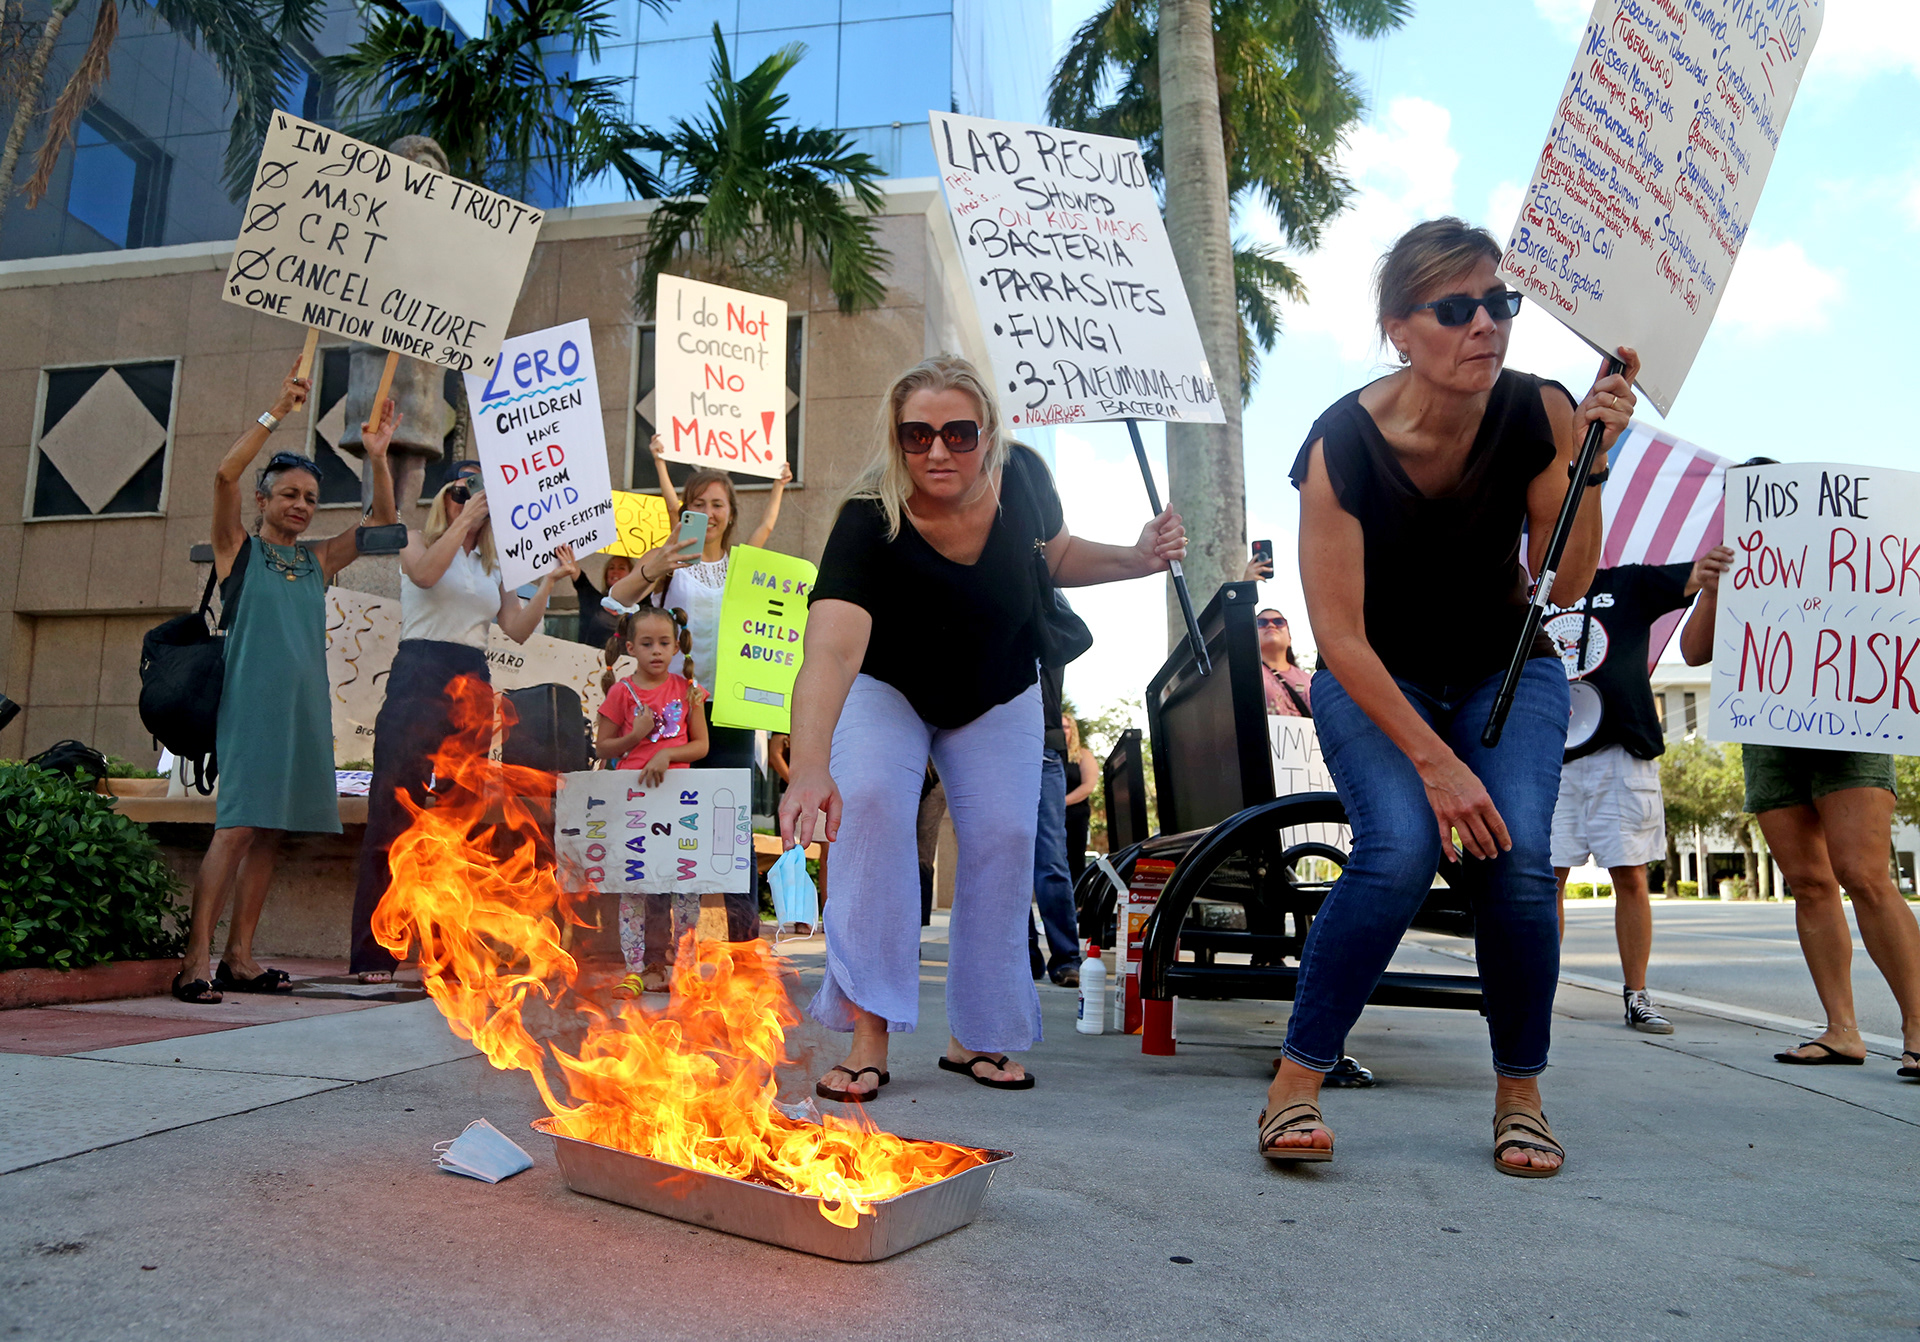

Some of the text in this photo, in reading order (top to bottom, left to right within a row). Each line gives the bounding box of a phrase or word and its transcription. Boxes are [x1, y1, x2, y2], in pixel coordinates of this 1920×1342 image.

[942, 119, 1145, 189] LAB RESULTS
[301, 179, 388, 227] MASK
[404, 165, 443, 200] WE
[1013, 176, 1115, 216] SHOWED
[970, 218, 1134, 268] BACTERIA
[998, 206, 1149, 242] ON KIDS MASKS
[1591, 226, 1616, 261] Coli
[276, 255, 369, 308] CANCEL
[380, 289, 486, 349] CULTURE
[986, 267, 1167, 316] PARASITES
[302, 302, 374, 337] NATION
[382, 325, 434, 359] UNDER
[676, 288, 770, 342] I do Not
[1007, 313, 1123, 355] FUNGI
[677, 331, 769, 371] Concent
[496, 388, 582, 435] CHILDREN
[690, 391, 742, 418] More
[1043, 403, 1086, 420] VIRUSES
[1096, 399, 1182, 419] BACTERIA
[527, 421, 561, 446] HAVE
[500, 444, 565, 485] DIED
[538, 467, 571, 492] FROM
[510, 486, 579, 531] COVID
[1745, 471, 1871, 523] KIDS ARE
[543, 498, 613, 541] PRE-EXISTING
[532, 529, 598, 570] CONTIONS
[1828, 527, 1920, 597] RISK
[1803, 598, 1822, 611] OR
[742, 619, 800, 643] CHILD
[740, 642, 795, 667] ABUSE
[1737, 621, 1920, 715] NO RISK
[1730, 698, 1756, 729] for
[624, 788, 647, 882] WANT
[651, 822, 672, 836] 2
[676, 790, 699, 881] WEAR
[734, 805, 751, 870] U CAN
